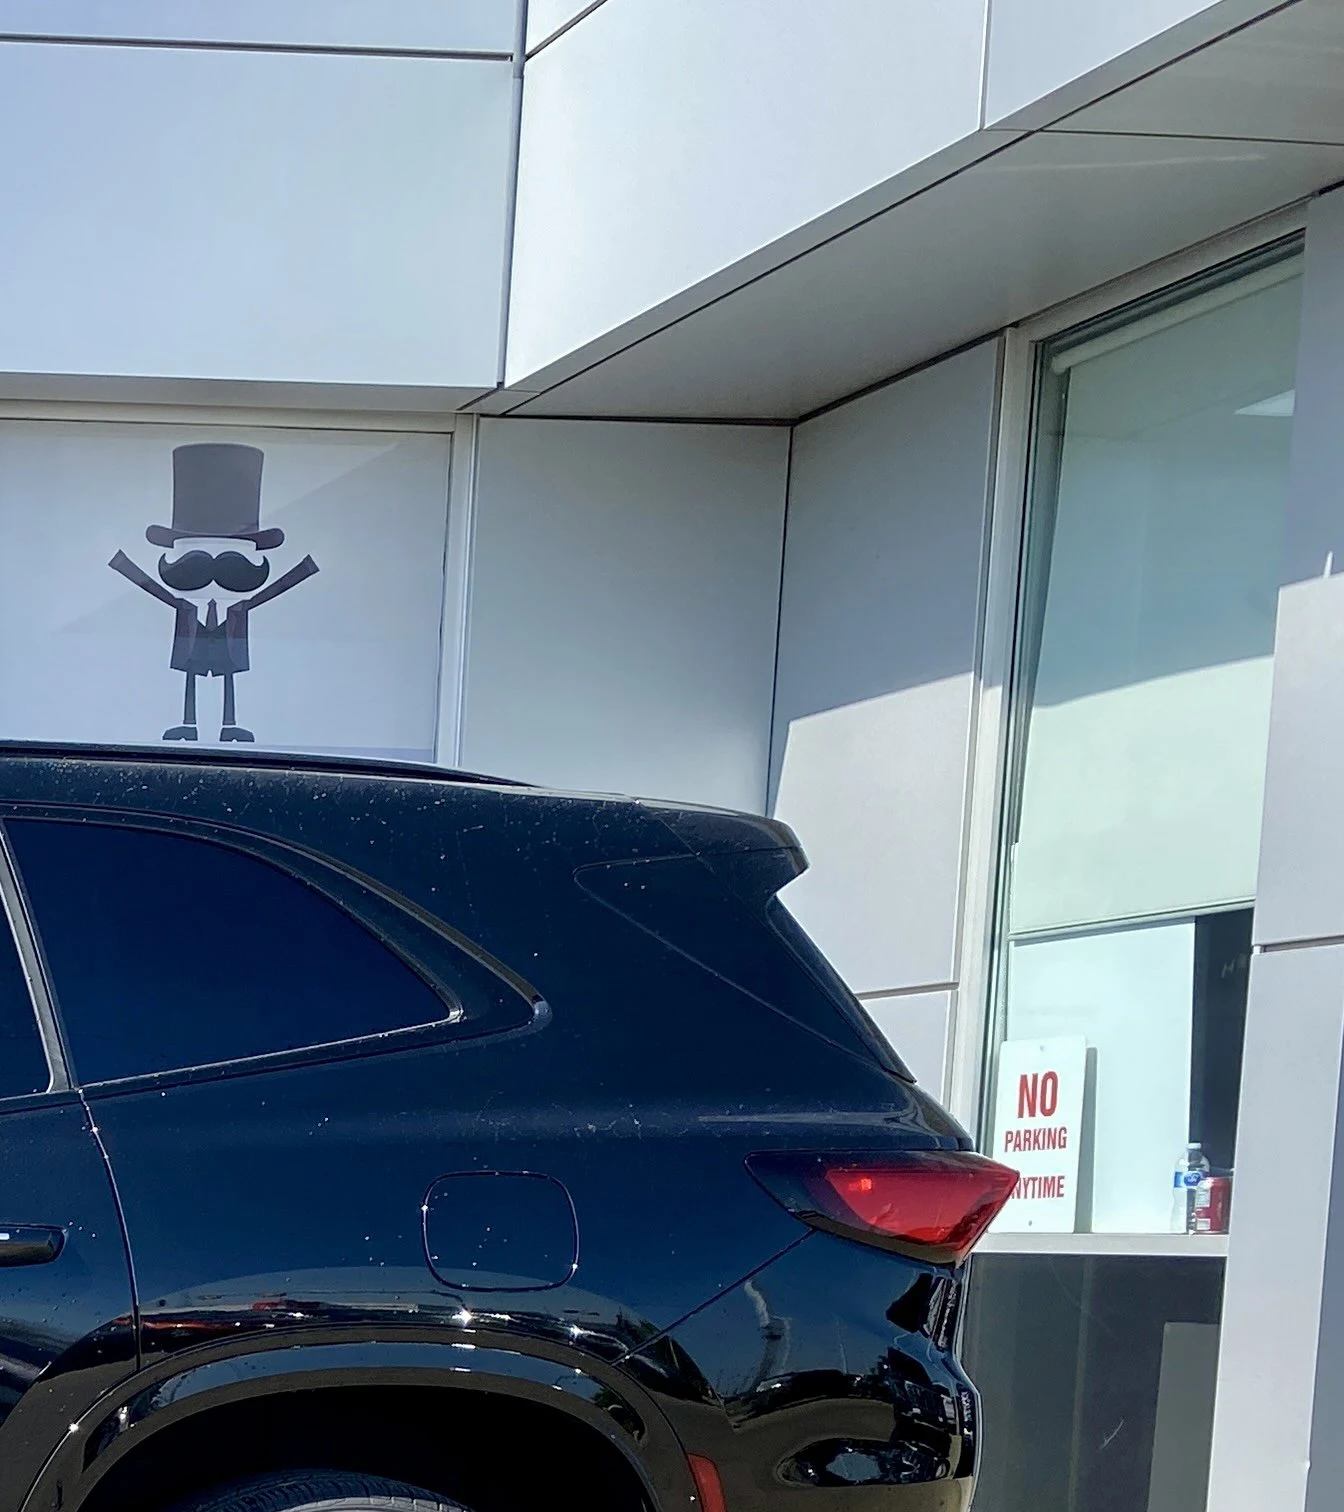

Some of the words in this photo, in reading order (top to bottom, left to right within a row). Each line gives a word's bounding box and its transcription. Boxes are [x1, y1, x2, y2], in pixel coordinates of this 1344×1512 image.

[1017, 1071, 1059, 1118] NO
[1004, 1126, 1067, 1153] PARKING
[1011, 1175, 1065, 1200] NYTIME
